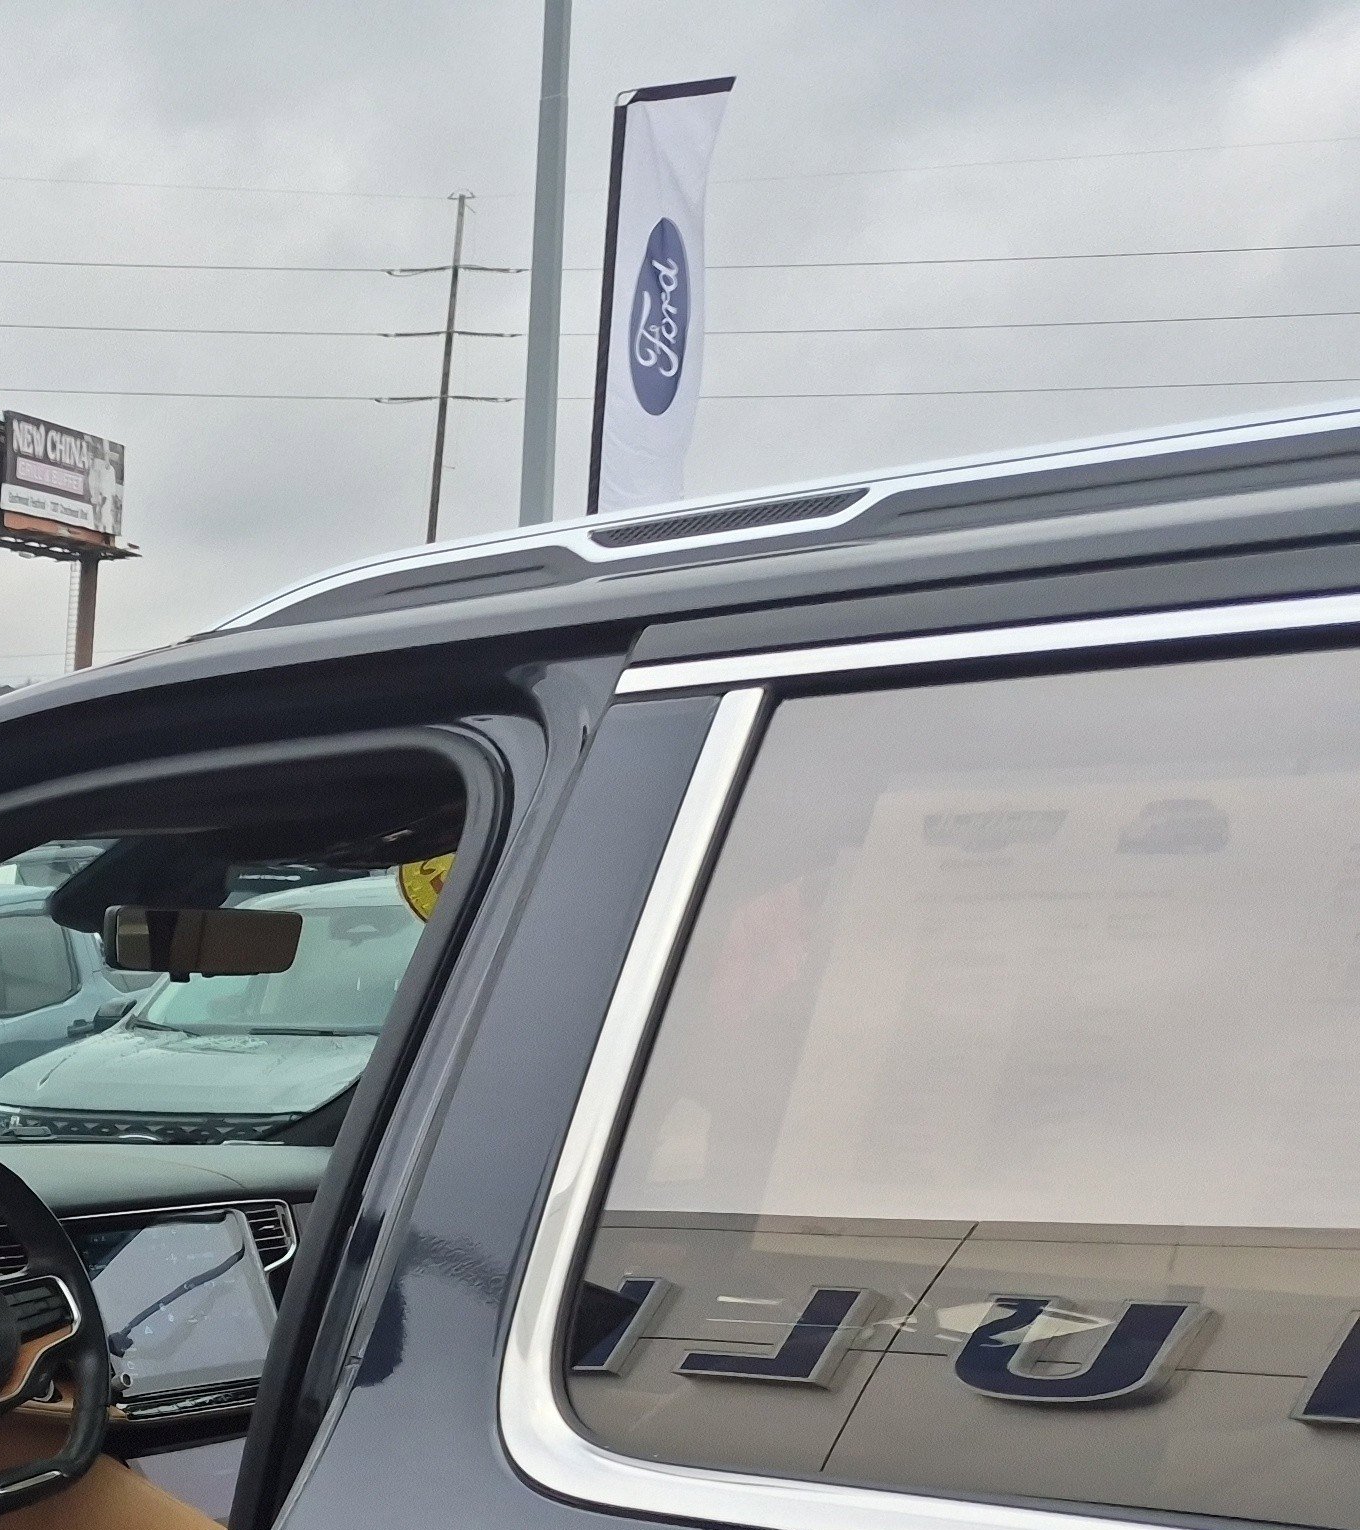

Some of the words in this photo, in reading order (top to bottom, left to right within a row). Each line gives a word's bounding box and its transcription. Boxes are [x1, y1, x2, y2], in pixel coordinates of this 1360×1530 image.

[635, 258, 679, 377] Ford
[12, 418, 46, 460] NEW
[46, 430, 88, 470] CHINA
